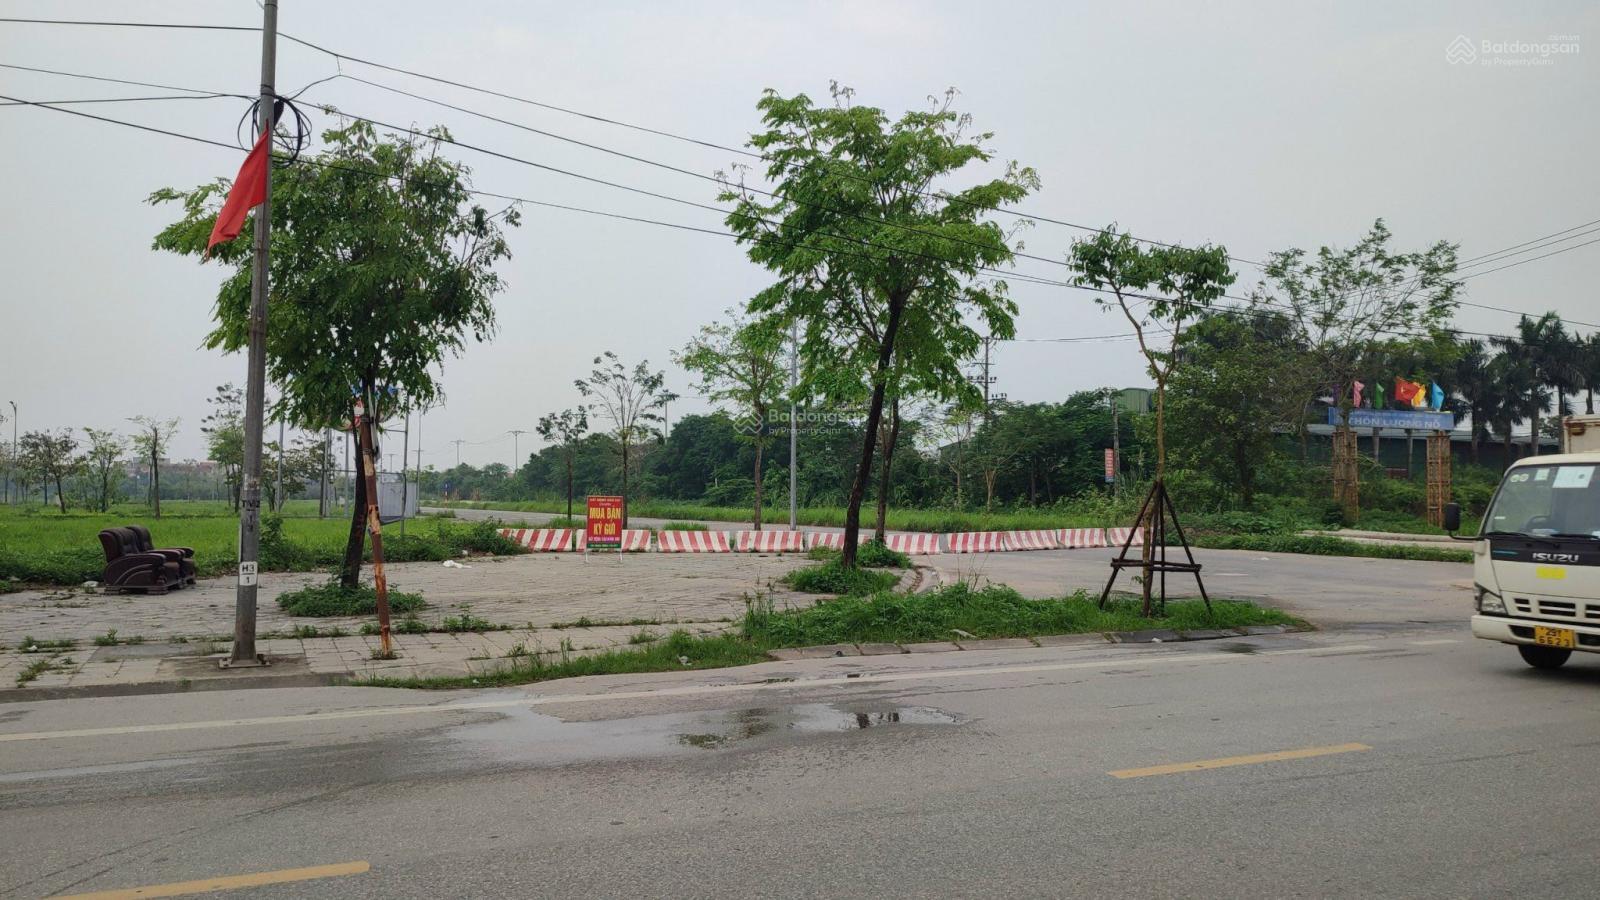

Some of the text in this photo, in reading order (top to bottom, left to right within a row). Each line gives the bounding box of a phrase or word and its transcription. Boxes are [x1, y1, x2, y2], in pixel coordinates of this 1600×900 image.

[589, 504, 622, 519] MUA BÁN
[1532, 552, 1580, 562] ISUZU
[242, 564, 255, 573] H3
